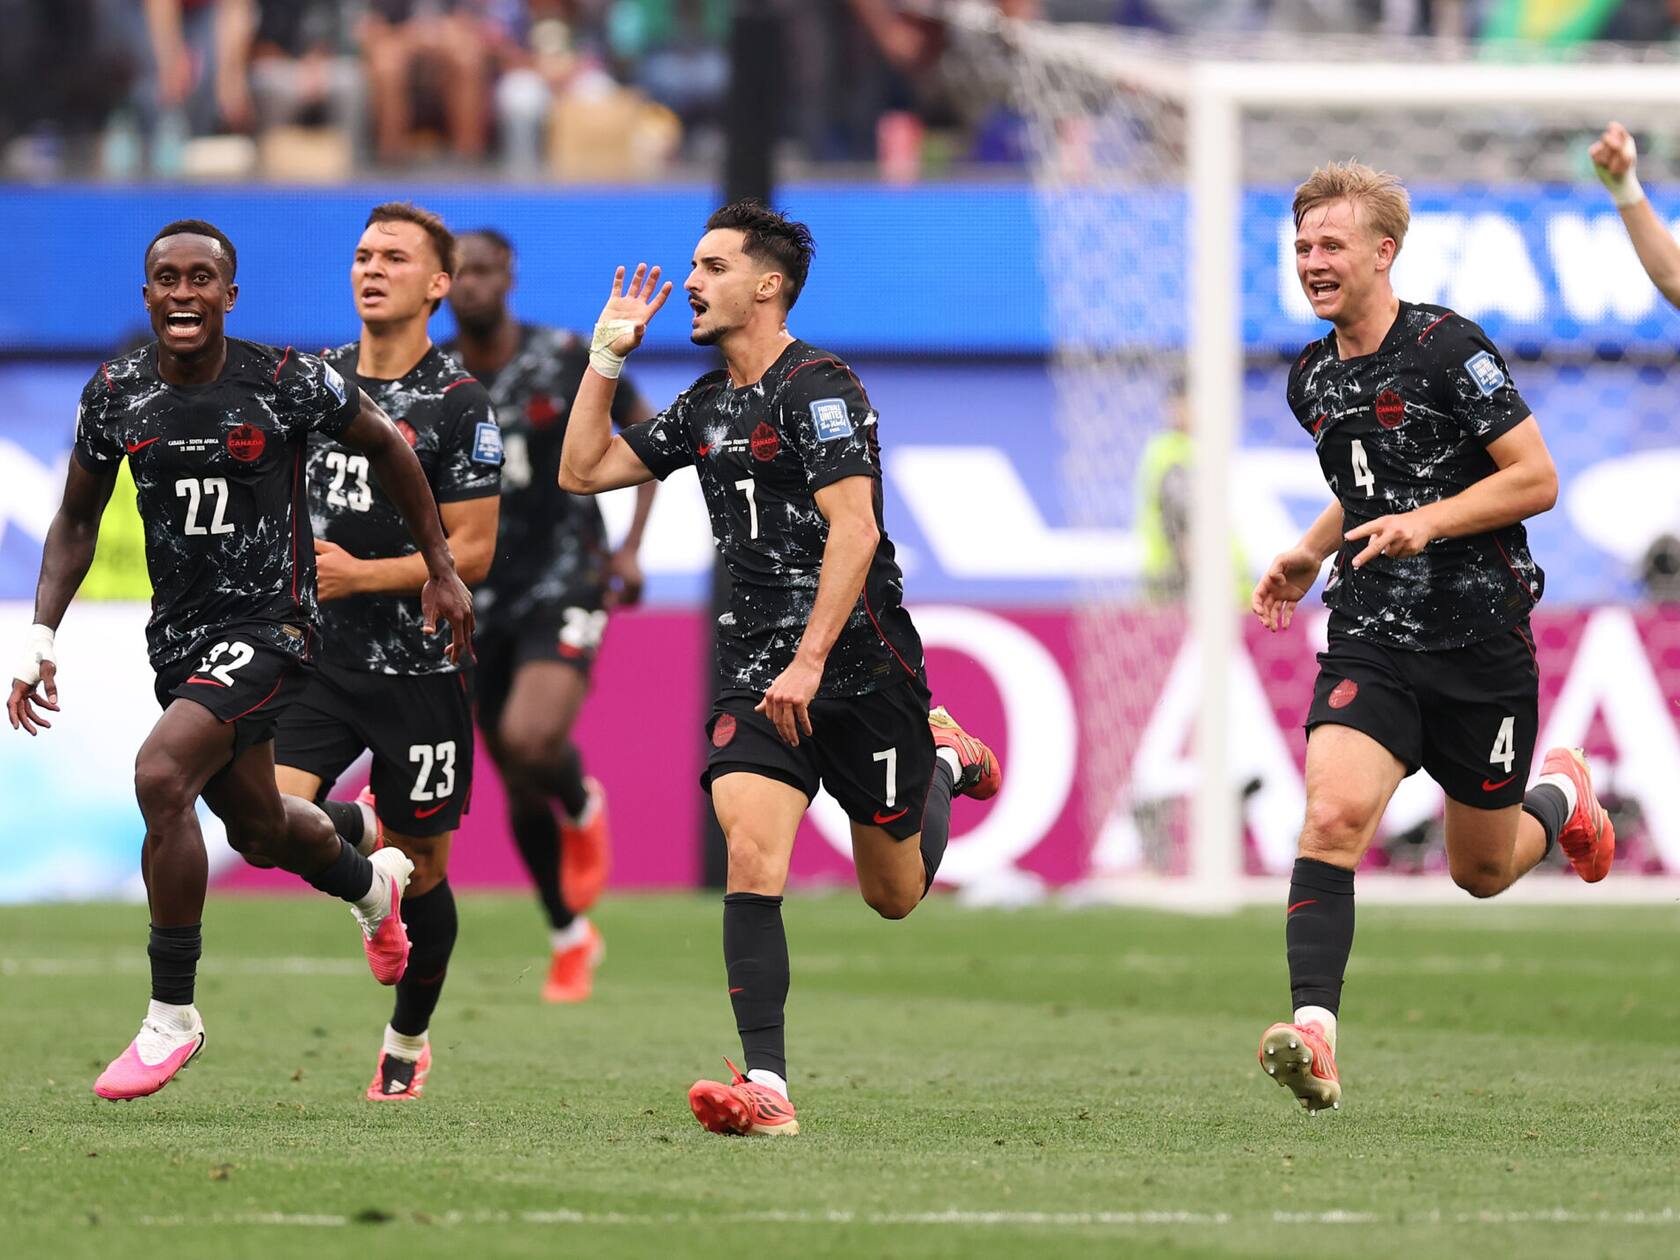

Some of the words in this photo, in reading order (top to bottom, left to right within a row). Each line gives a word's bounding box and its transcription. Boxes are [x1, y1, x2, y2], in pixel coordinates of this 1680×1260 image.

[1376, 404, 1403, 413] CANADA
[752, 436, 776, 448] CANADA
[1351, 439, 1375, 497] 4
[175, 477, 236, 536] 22
[325, 451, 371, 513] 23
[734, 478, 758, 540] 7
[408, 740, 456, 802] 23
[1489, 716, 1516, 774] 4
[872, 747, 897, 808] 7
